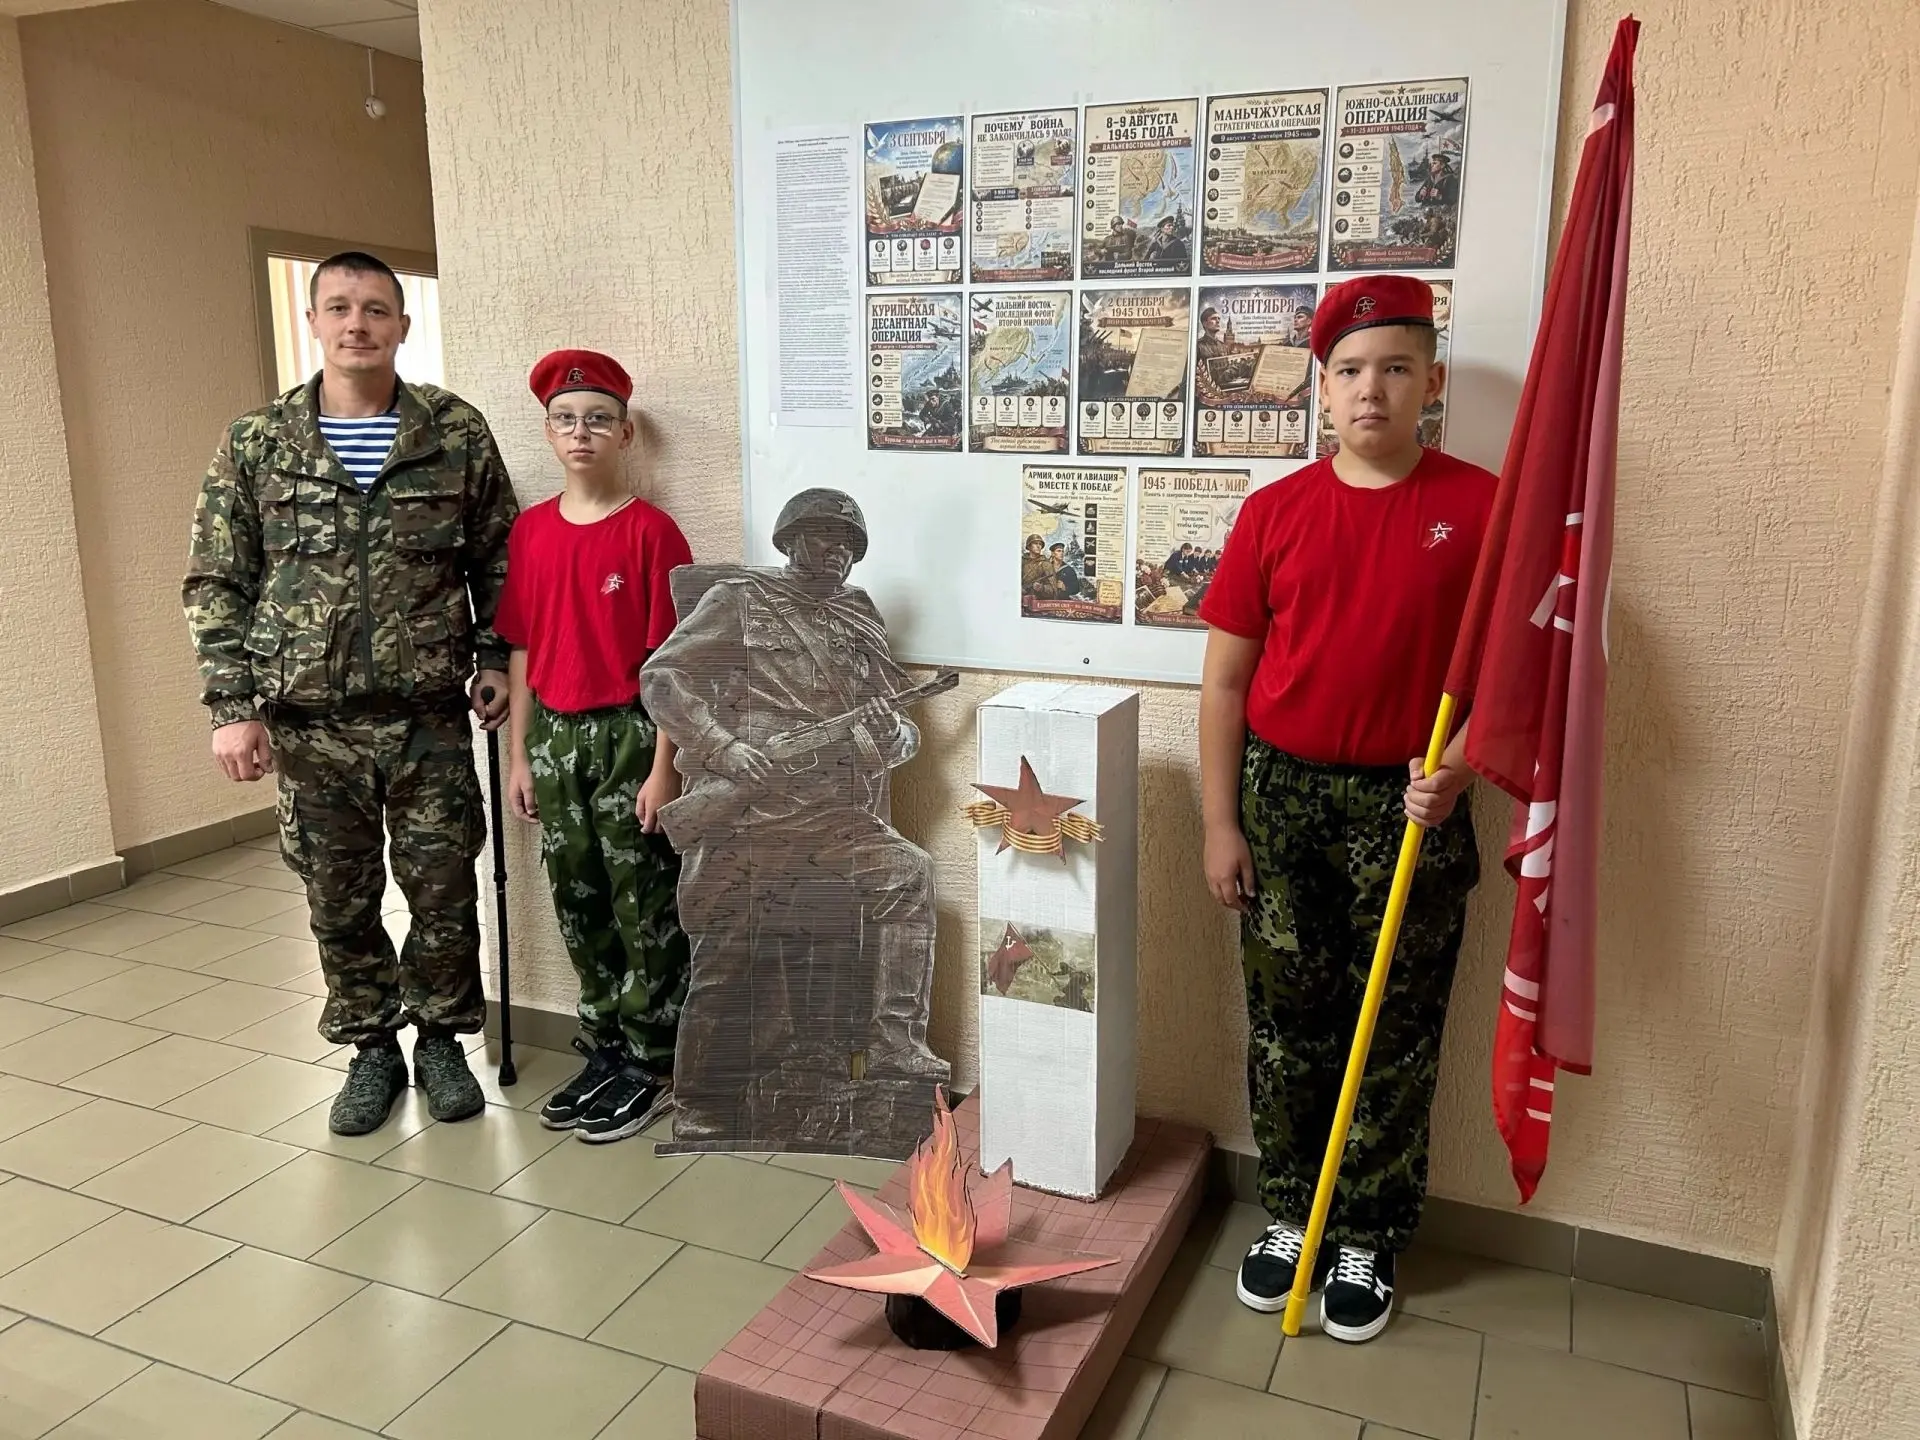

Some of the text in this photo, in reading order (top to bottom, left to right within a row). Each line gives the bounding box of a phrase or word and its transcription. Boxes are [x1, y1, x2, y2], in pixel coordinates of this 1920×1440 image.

[1345, 92, 1459, 110] ЮЖНО-САХАЛИНСКАЯ
[1129, 112, 1178, 127] АВГУСТА
[1214, 103, 1321, 122] МАНЬЧЖУРСКАЯ
[1345, 106, 1428, 125] ОПЕРАЦИЯ
[984, 117, 1064, 133] ПОЧЕМУ ВОЙНА
[1213, 116, 1321, 132] СТРАТЕГИЧЕСКАЯ ОПЕРАЦИЯ
[890, 131, 946, 148] 3 СЕНТЯБРЯ
[977, 128, 1072, 143] НЕ ЗАКОНЧИЛАСЬ 9 МАЯ?
[1109, 125, 1175, 141] 1945 ГОДА
[1220, 134, 1226, 142] 9
[1102, 139, 1182, 151] ДАЛЬНЕВОСТОЧНЫЙ ФРОНТ
[995, 300, 1026, 310] ДАЛЬНИЙ
[1027, 300, 1052, 309] ВОСТОК
[1108, 296, 1165, 307] 2 СЕНТЯБРЯ
[1221, 298, 1295, 314] 3 СЕНТЯБРЯ
[872, 303, 935, 317] КУРИЛЬСКАЯ
[995, 309, 1055, 318] ПОСЛЕДНИЙ ФРОНТ
[1112, 307, 1161, 317] 1945 ГОДА
[871, 317, 927, 331] ДЕСАНТНАЯ
[998, 317, 1053, 327] ВТОРОЙ МИРОВОЙ
[872, 330, 922, 344] ОПЕРАЦИЯ
[1028, 471, 1054, 480] АРМИЯ,
[1055, 472, 1075, 480] ФЛОТ
[1084, 473, 1118, 481] АВИАЦИЯ
[1039, 481, 1113, 492] ВМЕСТЕ К ПОБЕДЕ
[1143, 476, 1166, 490] 1945
[1173, 477, 1218, 492] ПОБЕДА
[1224, 478, 1248, 492] МИР
